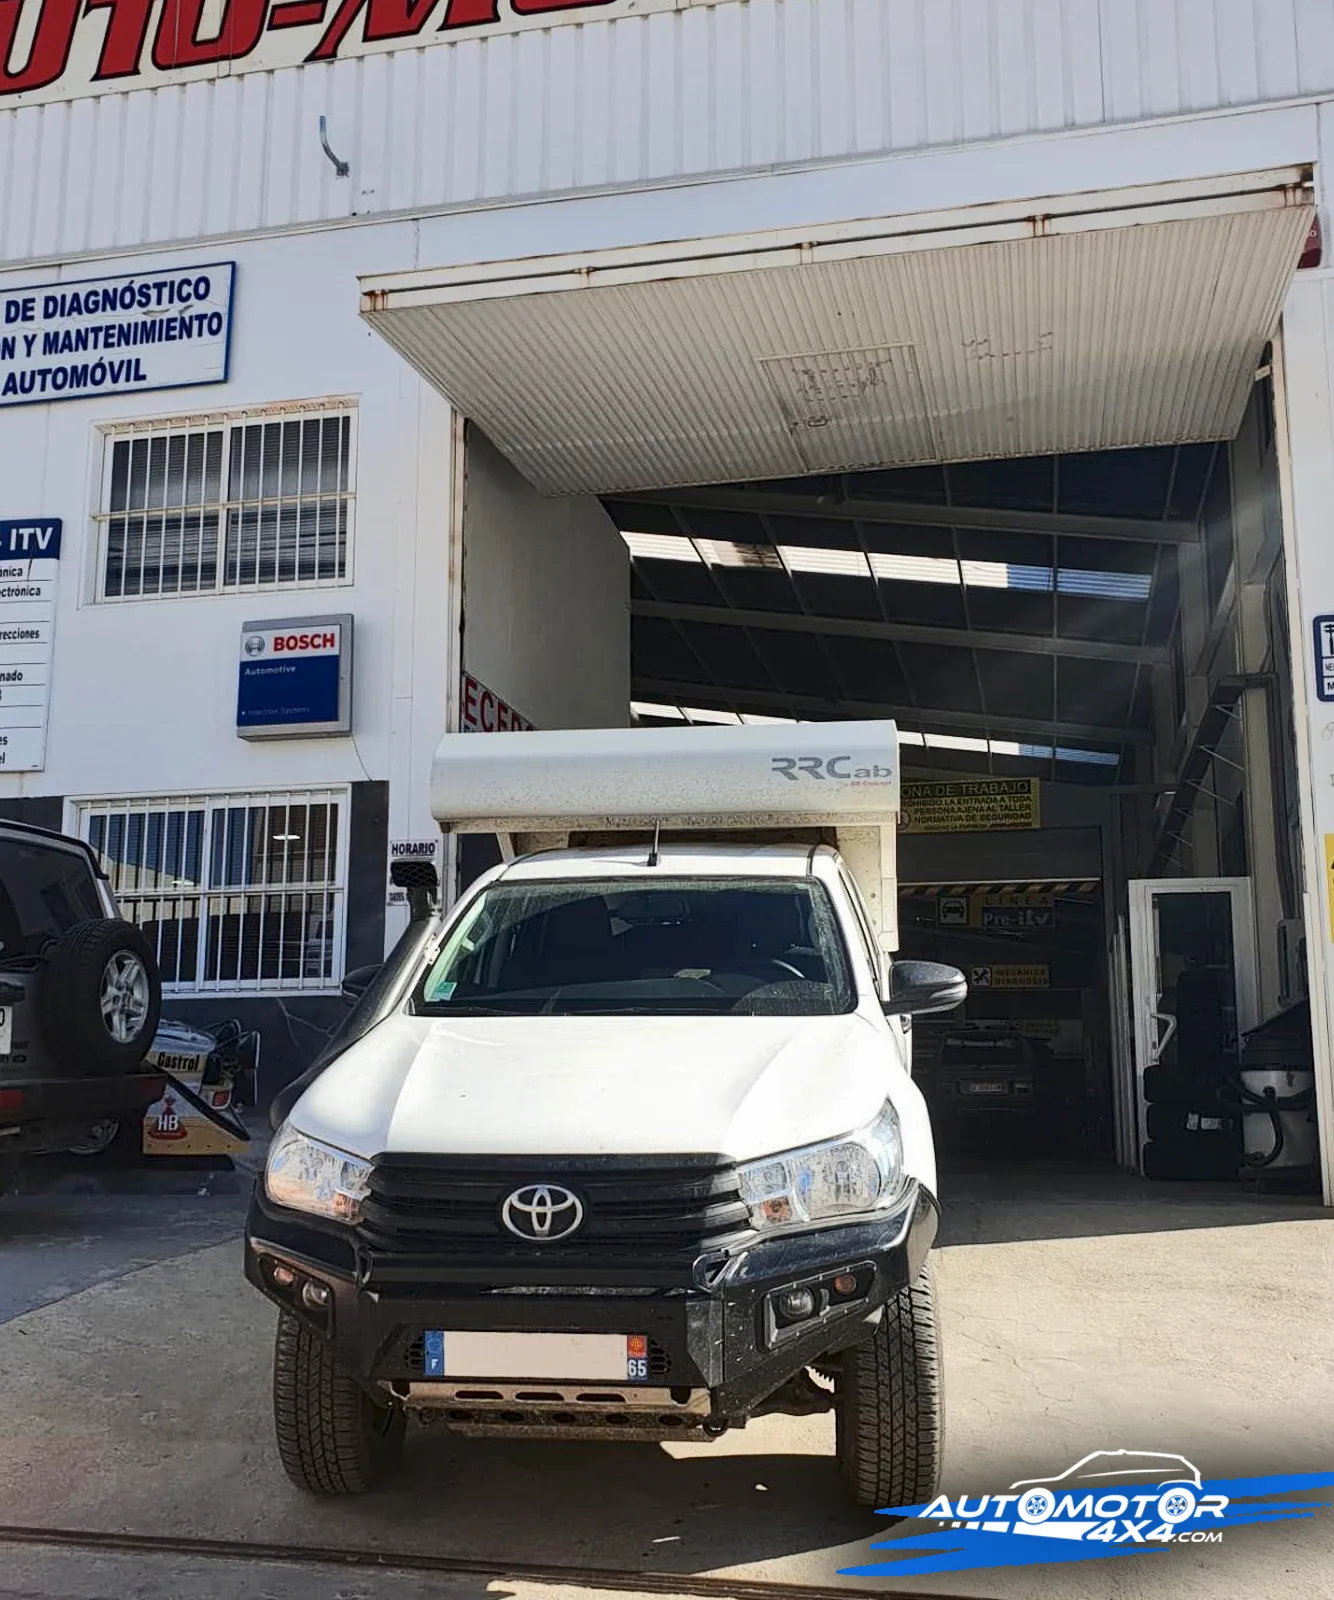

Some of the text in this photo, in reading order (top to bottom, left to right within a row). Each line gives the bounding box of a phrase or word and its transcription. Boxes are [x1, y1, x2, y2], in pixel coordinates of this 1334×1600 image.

[5, 276, 211, 324] DE DIAGNÓSTICO
[23, 333, 37, 358] Y
[42, 311, 223, 356] MANTENIMIENTO
[2, 356, 147, 396] AUTOMÓVIL
[9, 526, 54, 551] ITV
[273, 632, 335, 652] BOSCH
[901, 780, 1029, 798] ONA DE TRABAJO
[391, 842, 436, 855] HORARIO
[157, 1052, 200, 1071] Castrol
[158, 1114, 180, 1131] HB
[431, 1358, 438, 1370] F
[628, 1359, 647, 1377] 65
